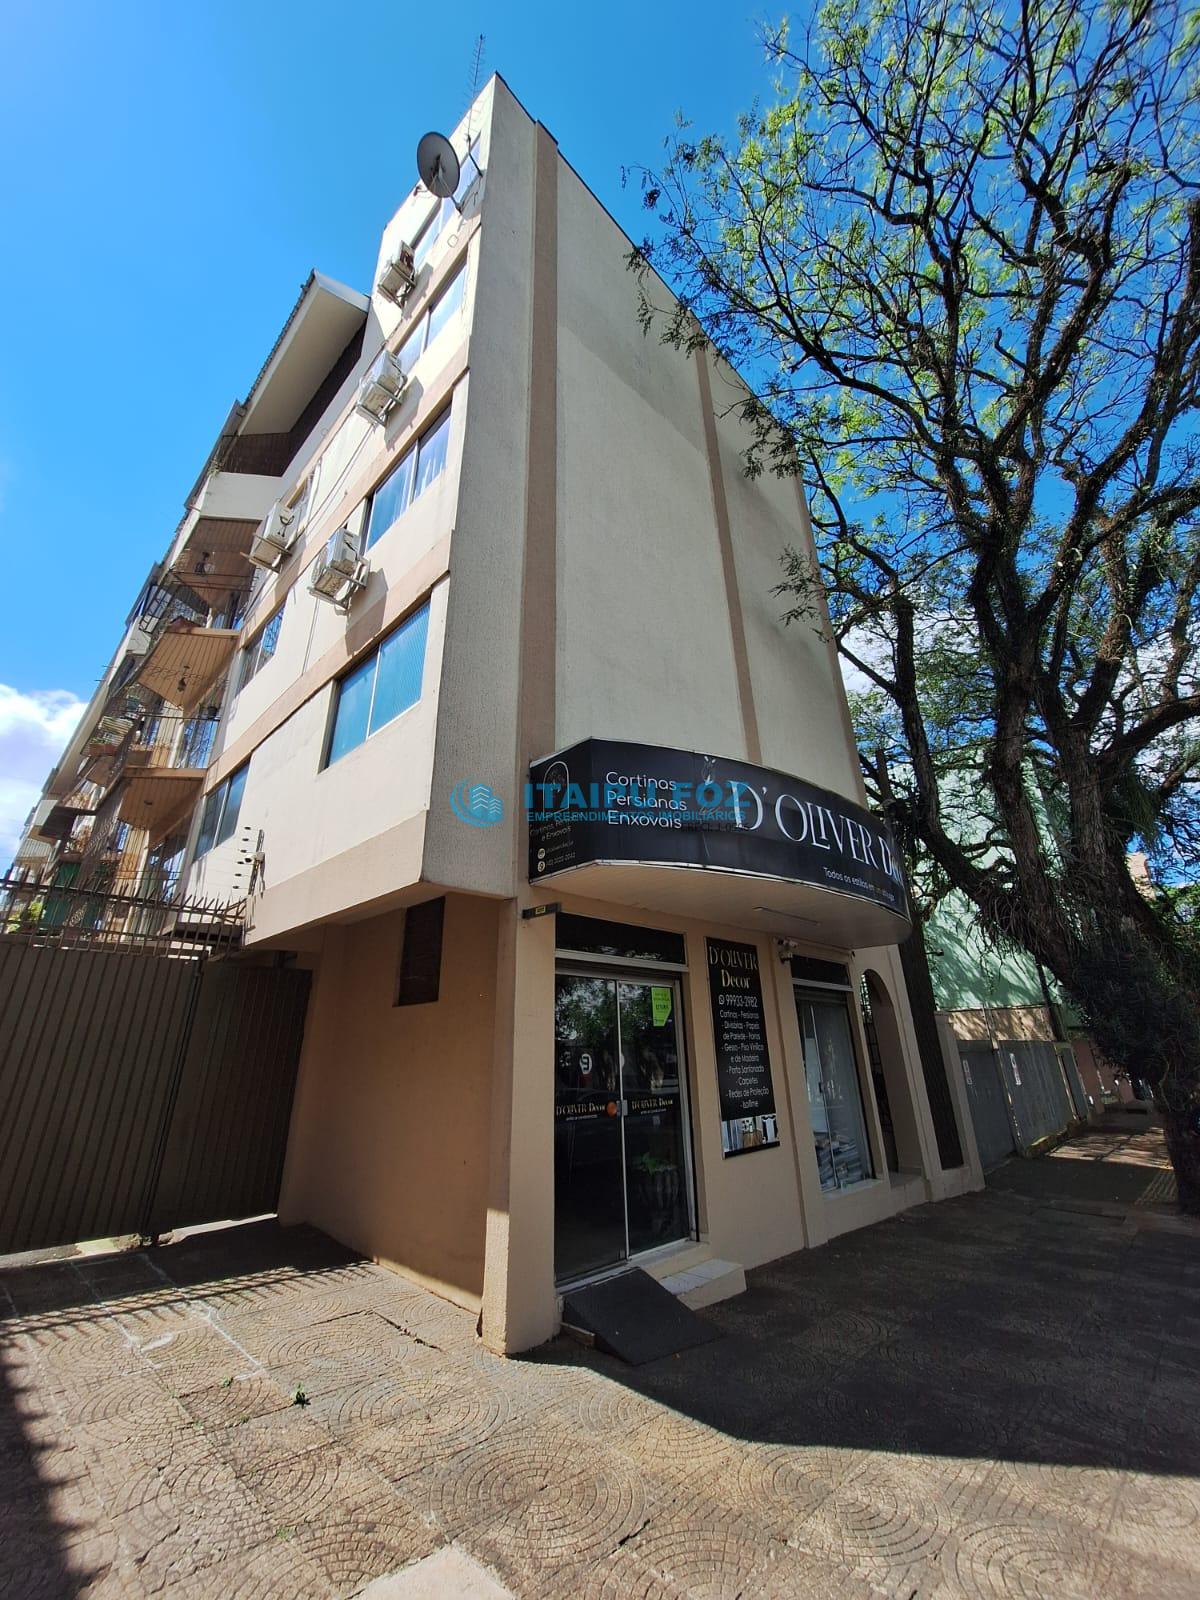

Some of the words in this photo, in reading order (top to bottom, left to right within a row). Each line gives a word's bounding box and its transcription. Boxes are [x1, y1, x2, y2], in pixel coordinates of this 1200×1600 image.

[606, 771, 677, 791] Cortinas
[607, 792, 687, 811] Persianas
[608, 810, 682, 829] Enxovais
[721, 968, 750, 989] Decor
